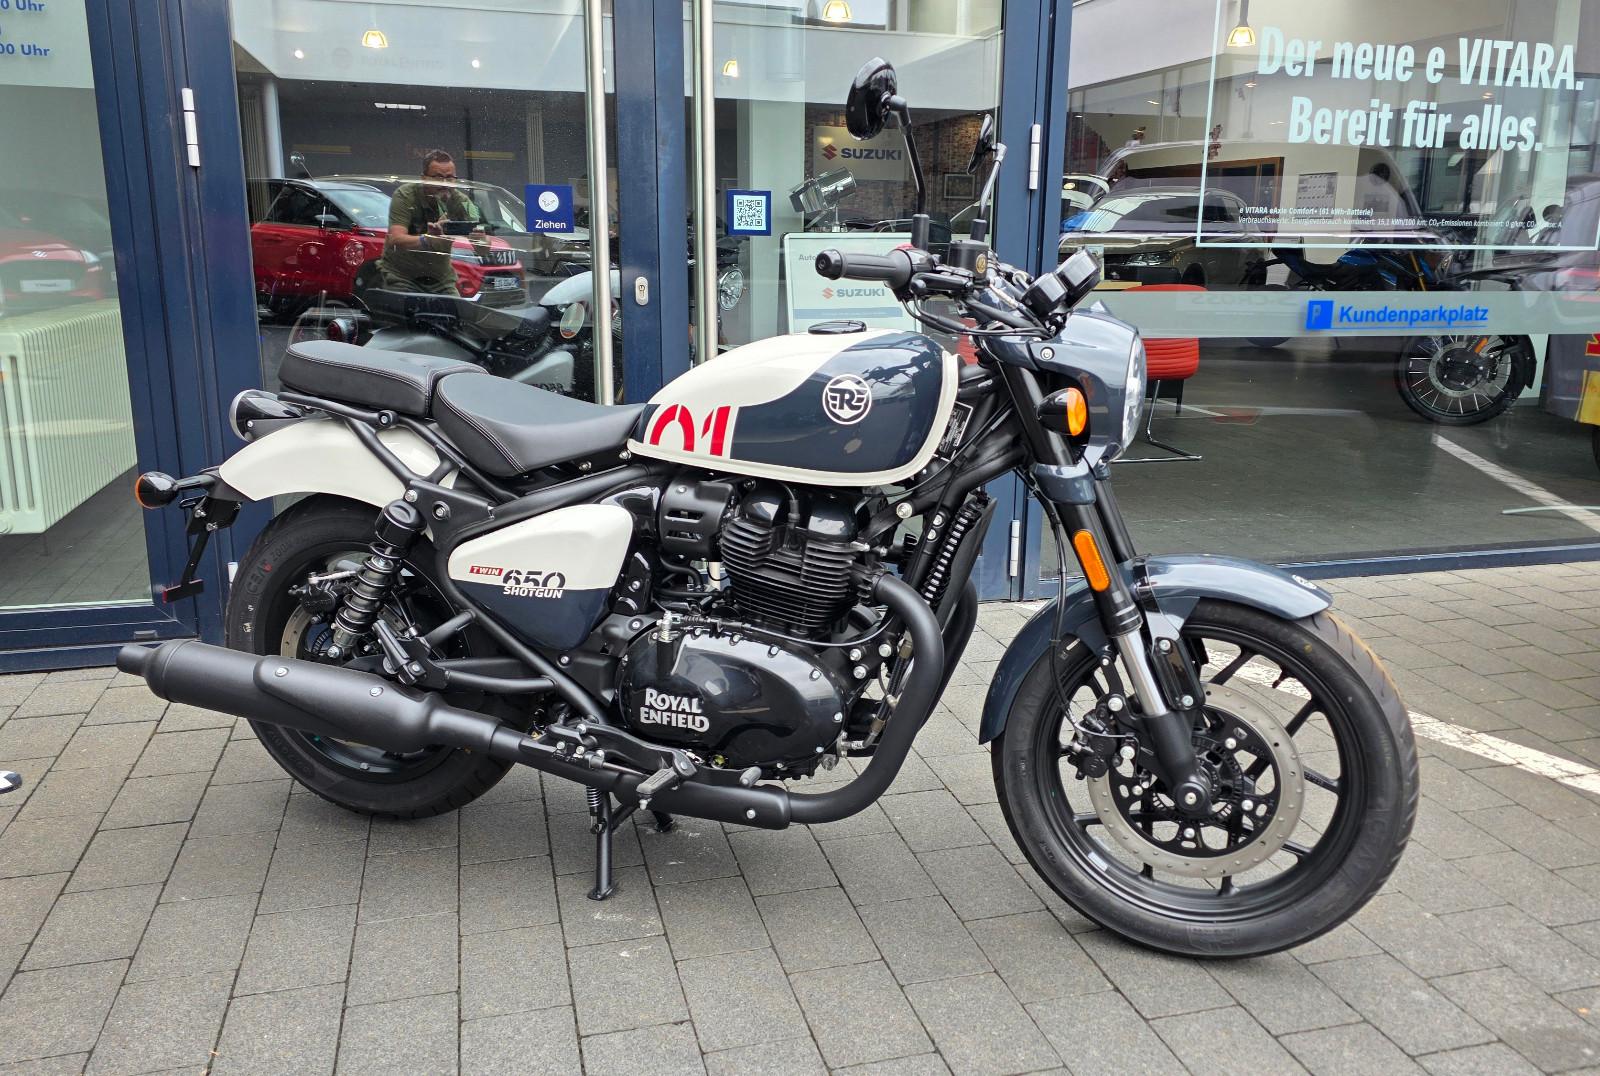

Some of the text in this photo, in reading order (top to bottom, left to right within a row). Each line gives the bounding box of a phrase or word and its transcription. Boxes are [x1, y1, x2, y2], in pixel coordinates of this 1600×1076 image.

[15, 0, 46, 12] Uhr
[21, 44, 50, 56] Uhr
[1257, 25, 1585, 92] Der neue e VITARA.
[1288, 96, 1544, 152] Bereit für alles.
[840, 147, 902, 161] SUZUKI
[1245, 206, 1268, 214] VITARA
[535, 219, 567, 229] Ziehen
[836, 287, 885, 298] SUZUKI
[1339, 305, 1489, 326] Kundenparkplatz
[472, 566, 566, 588] TWIN 650
[503, 586, 564, 599] SHOTGUN
[645, 687, 702, 713] ROYAL
[640, 706, 710, 732] ENFIELD
